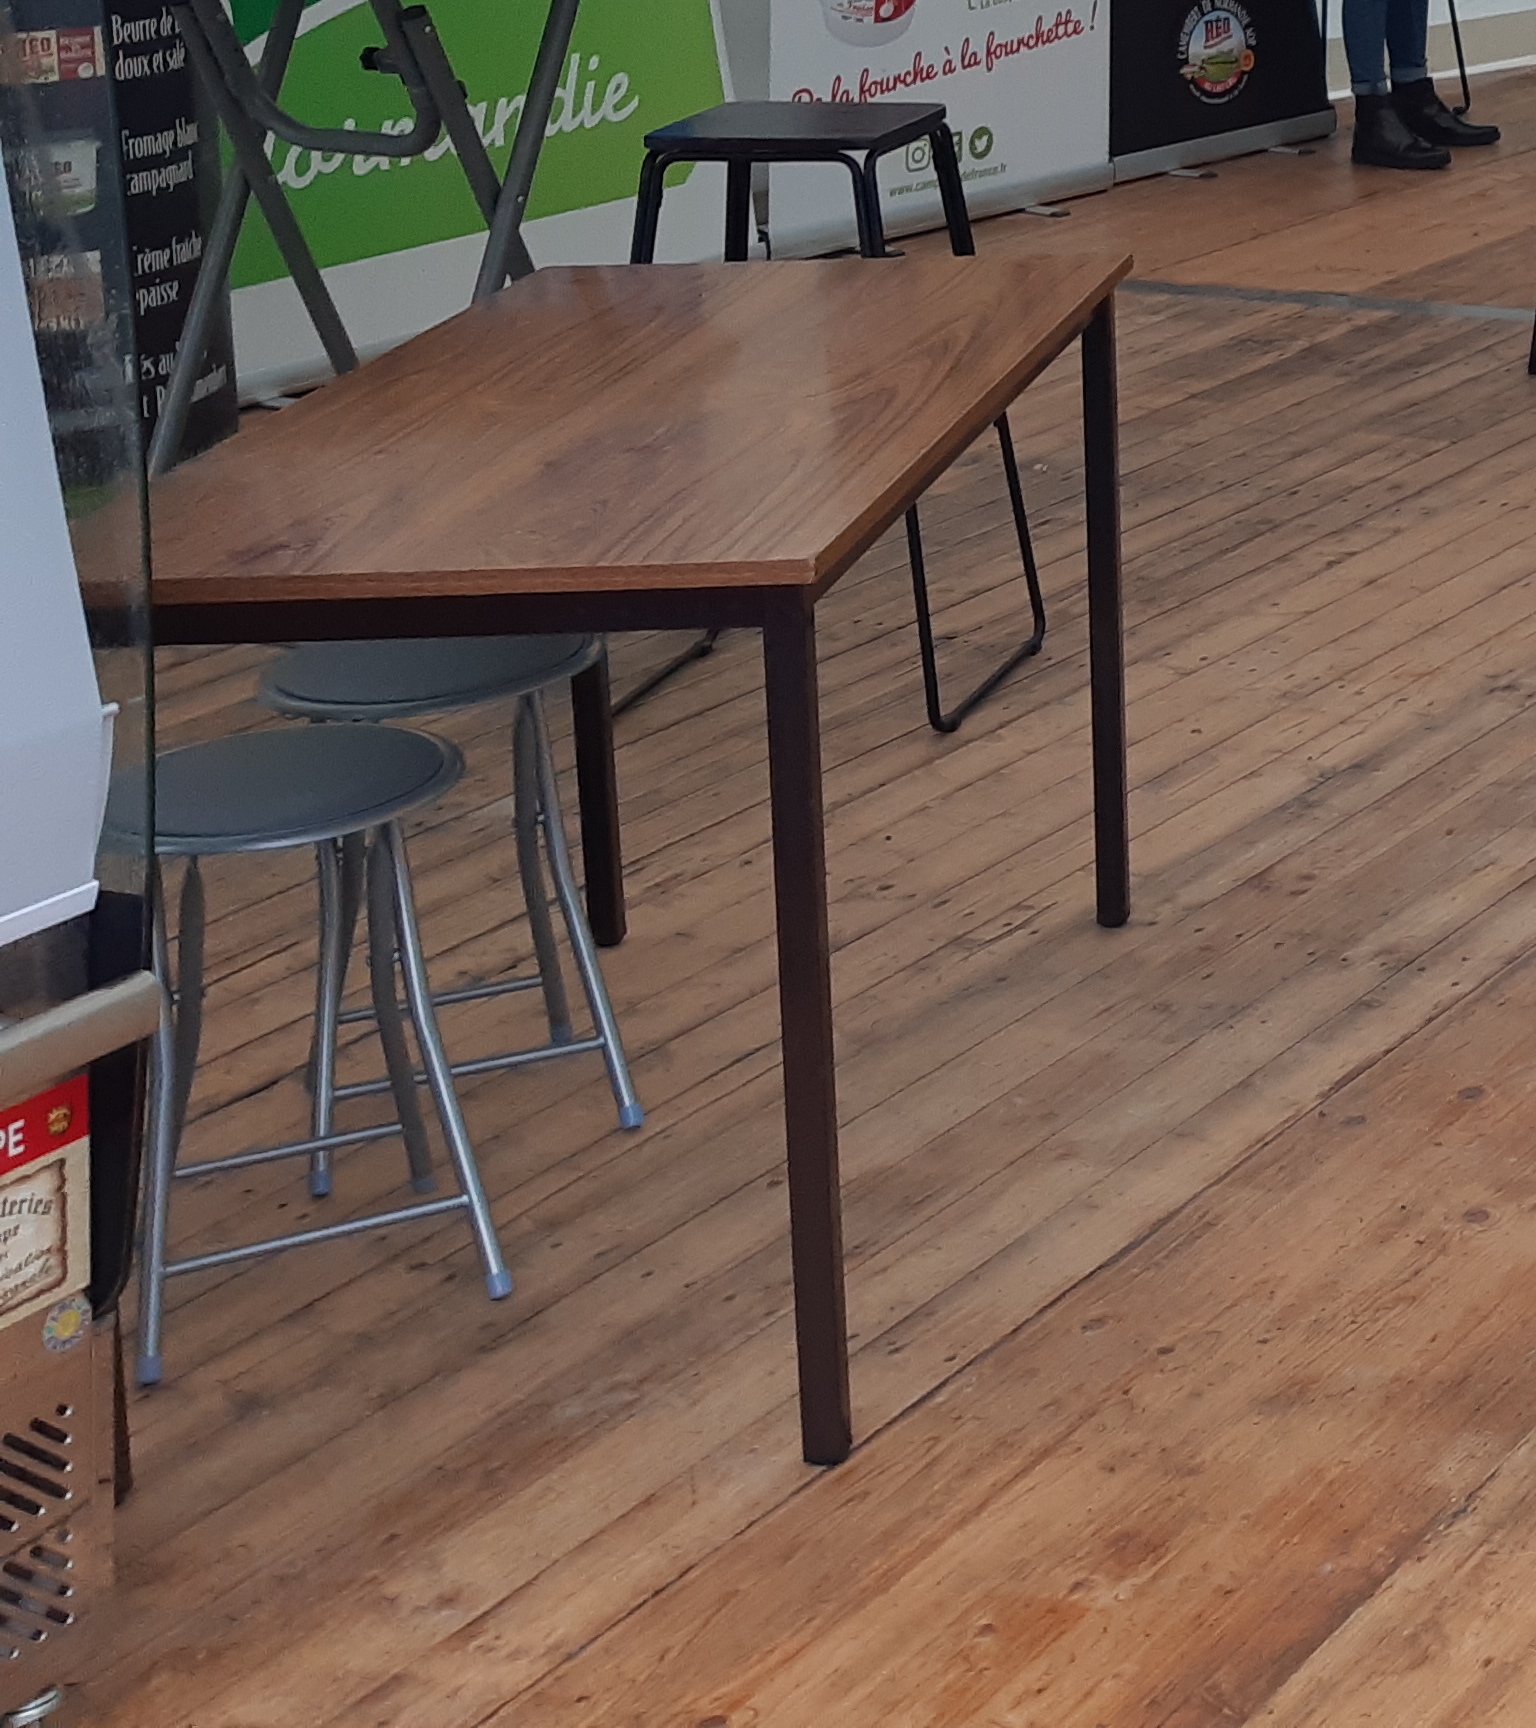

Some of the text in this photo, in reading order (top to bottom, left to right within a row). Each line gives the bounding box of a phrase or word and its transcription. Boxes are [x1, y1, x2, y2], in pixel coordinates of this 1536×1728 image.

[111, 6, 173, 46] Beurre de
[942, 46, 956, 76] à
[961, 37, 982, 70] la
[985, 9, 1084, 73] fourchette
[115, 50, 150, 81] doux
[122, 126, 173, 161] Fromage
